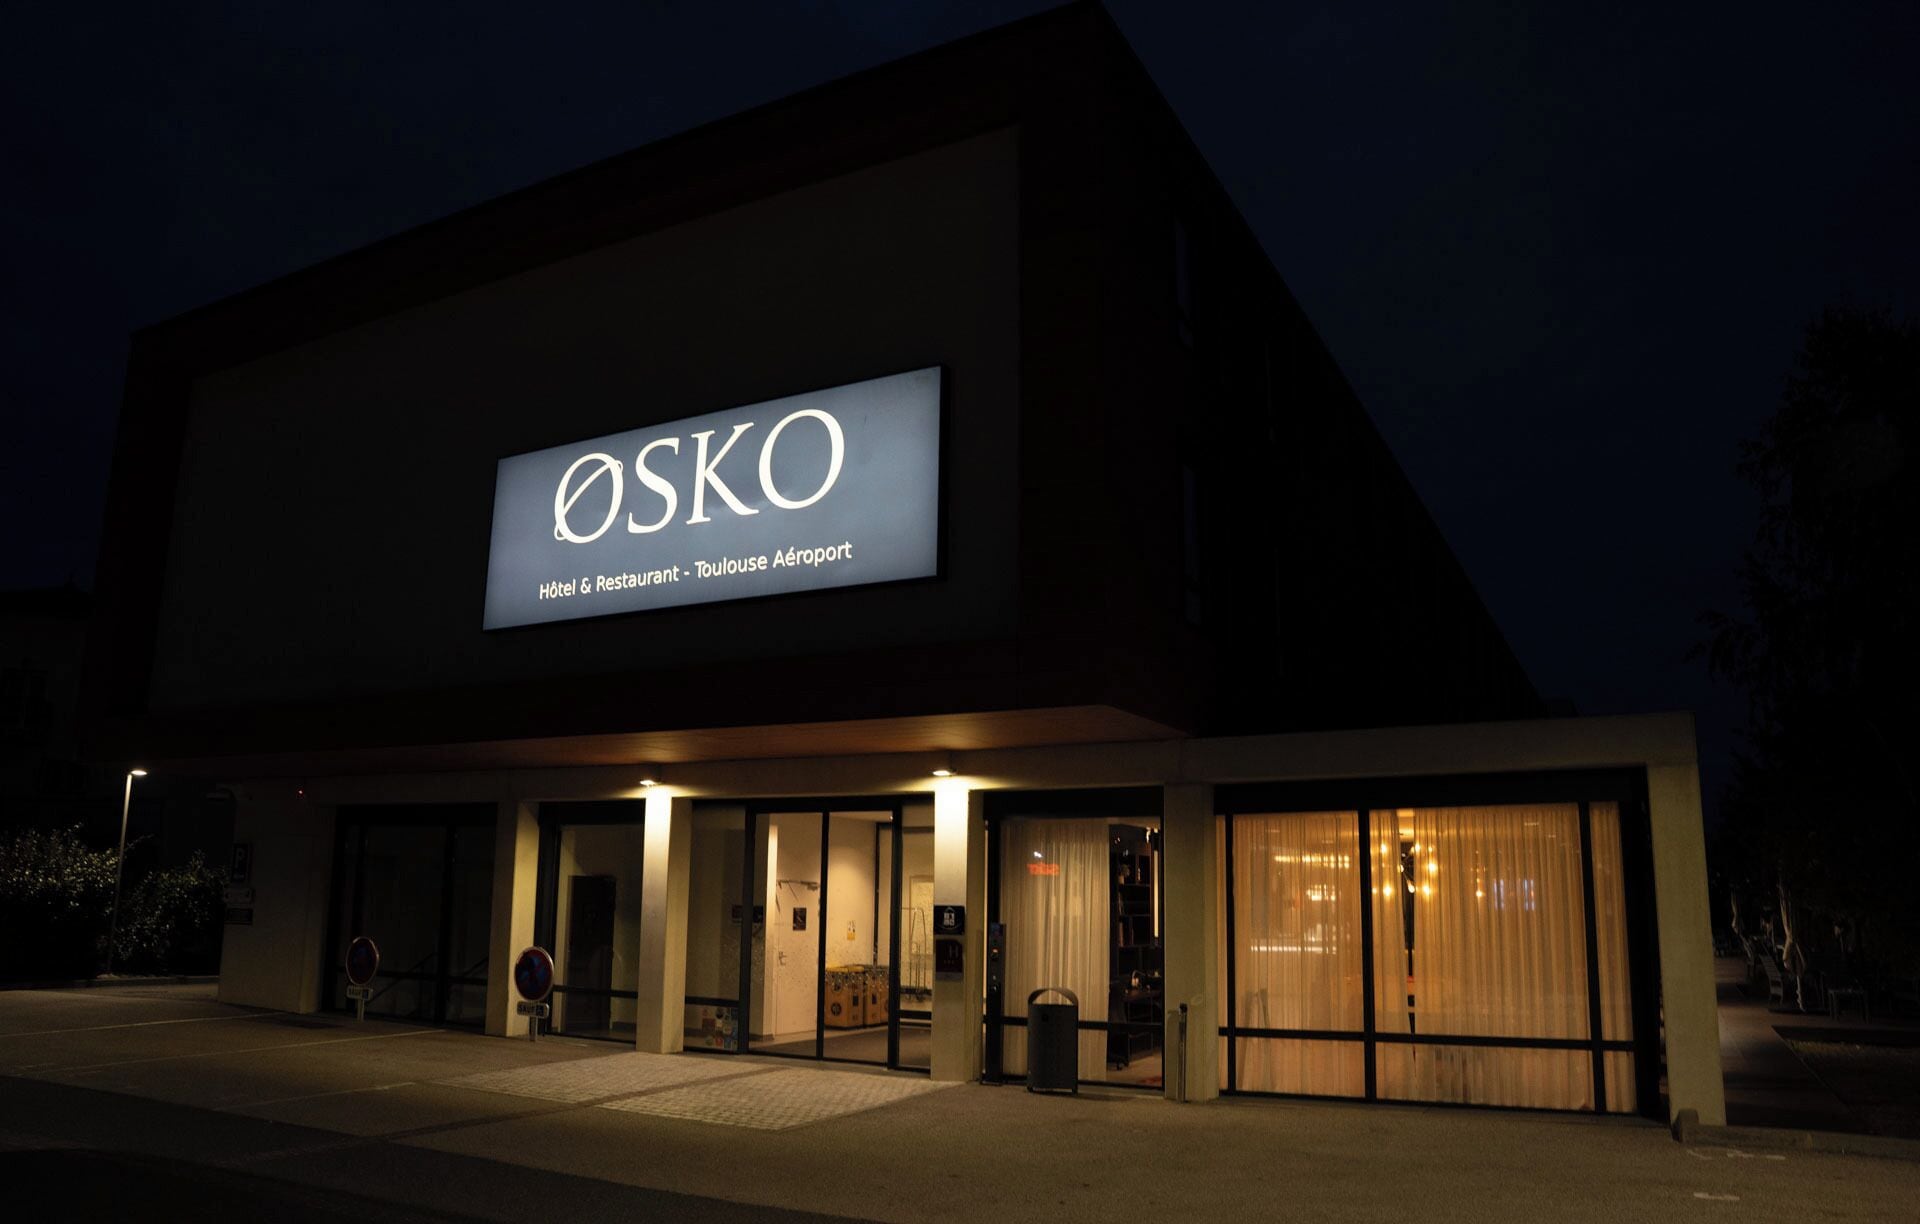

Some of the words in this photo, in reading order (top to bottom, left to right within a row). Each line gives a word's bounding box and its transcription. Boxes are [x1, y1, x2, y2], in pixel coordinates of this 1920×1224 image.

[539, 579, 577, 600] Hôtel
[581, 577, 592, 594] &
[596, 566, 680, 593] Restaurant
[694, 553, 768, 580] Toulouse
[772, 540, 853, 569] Aéroport
